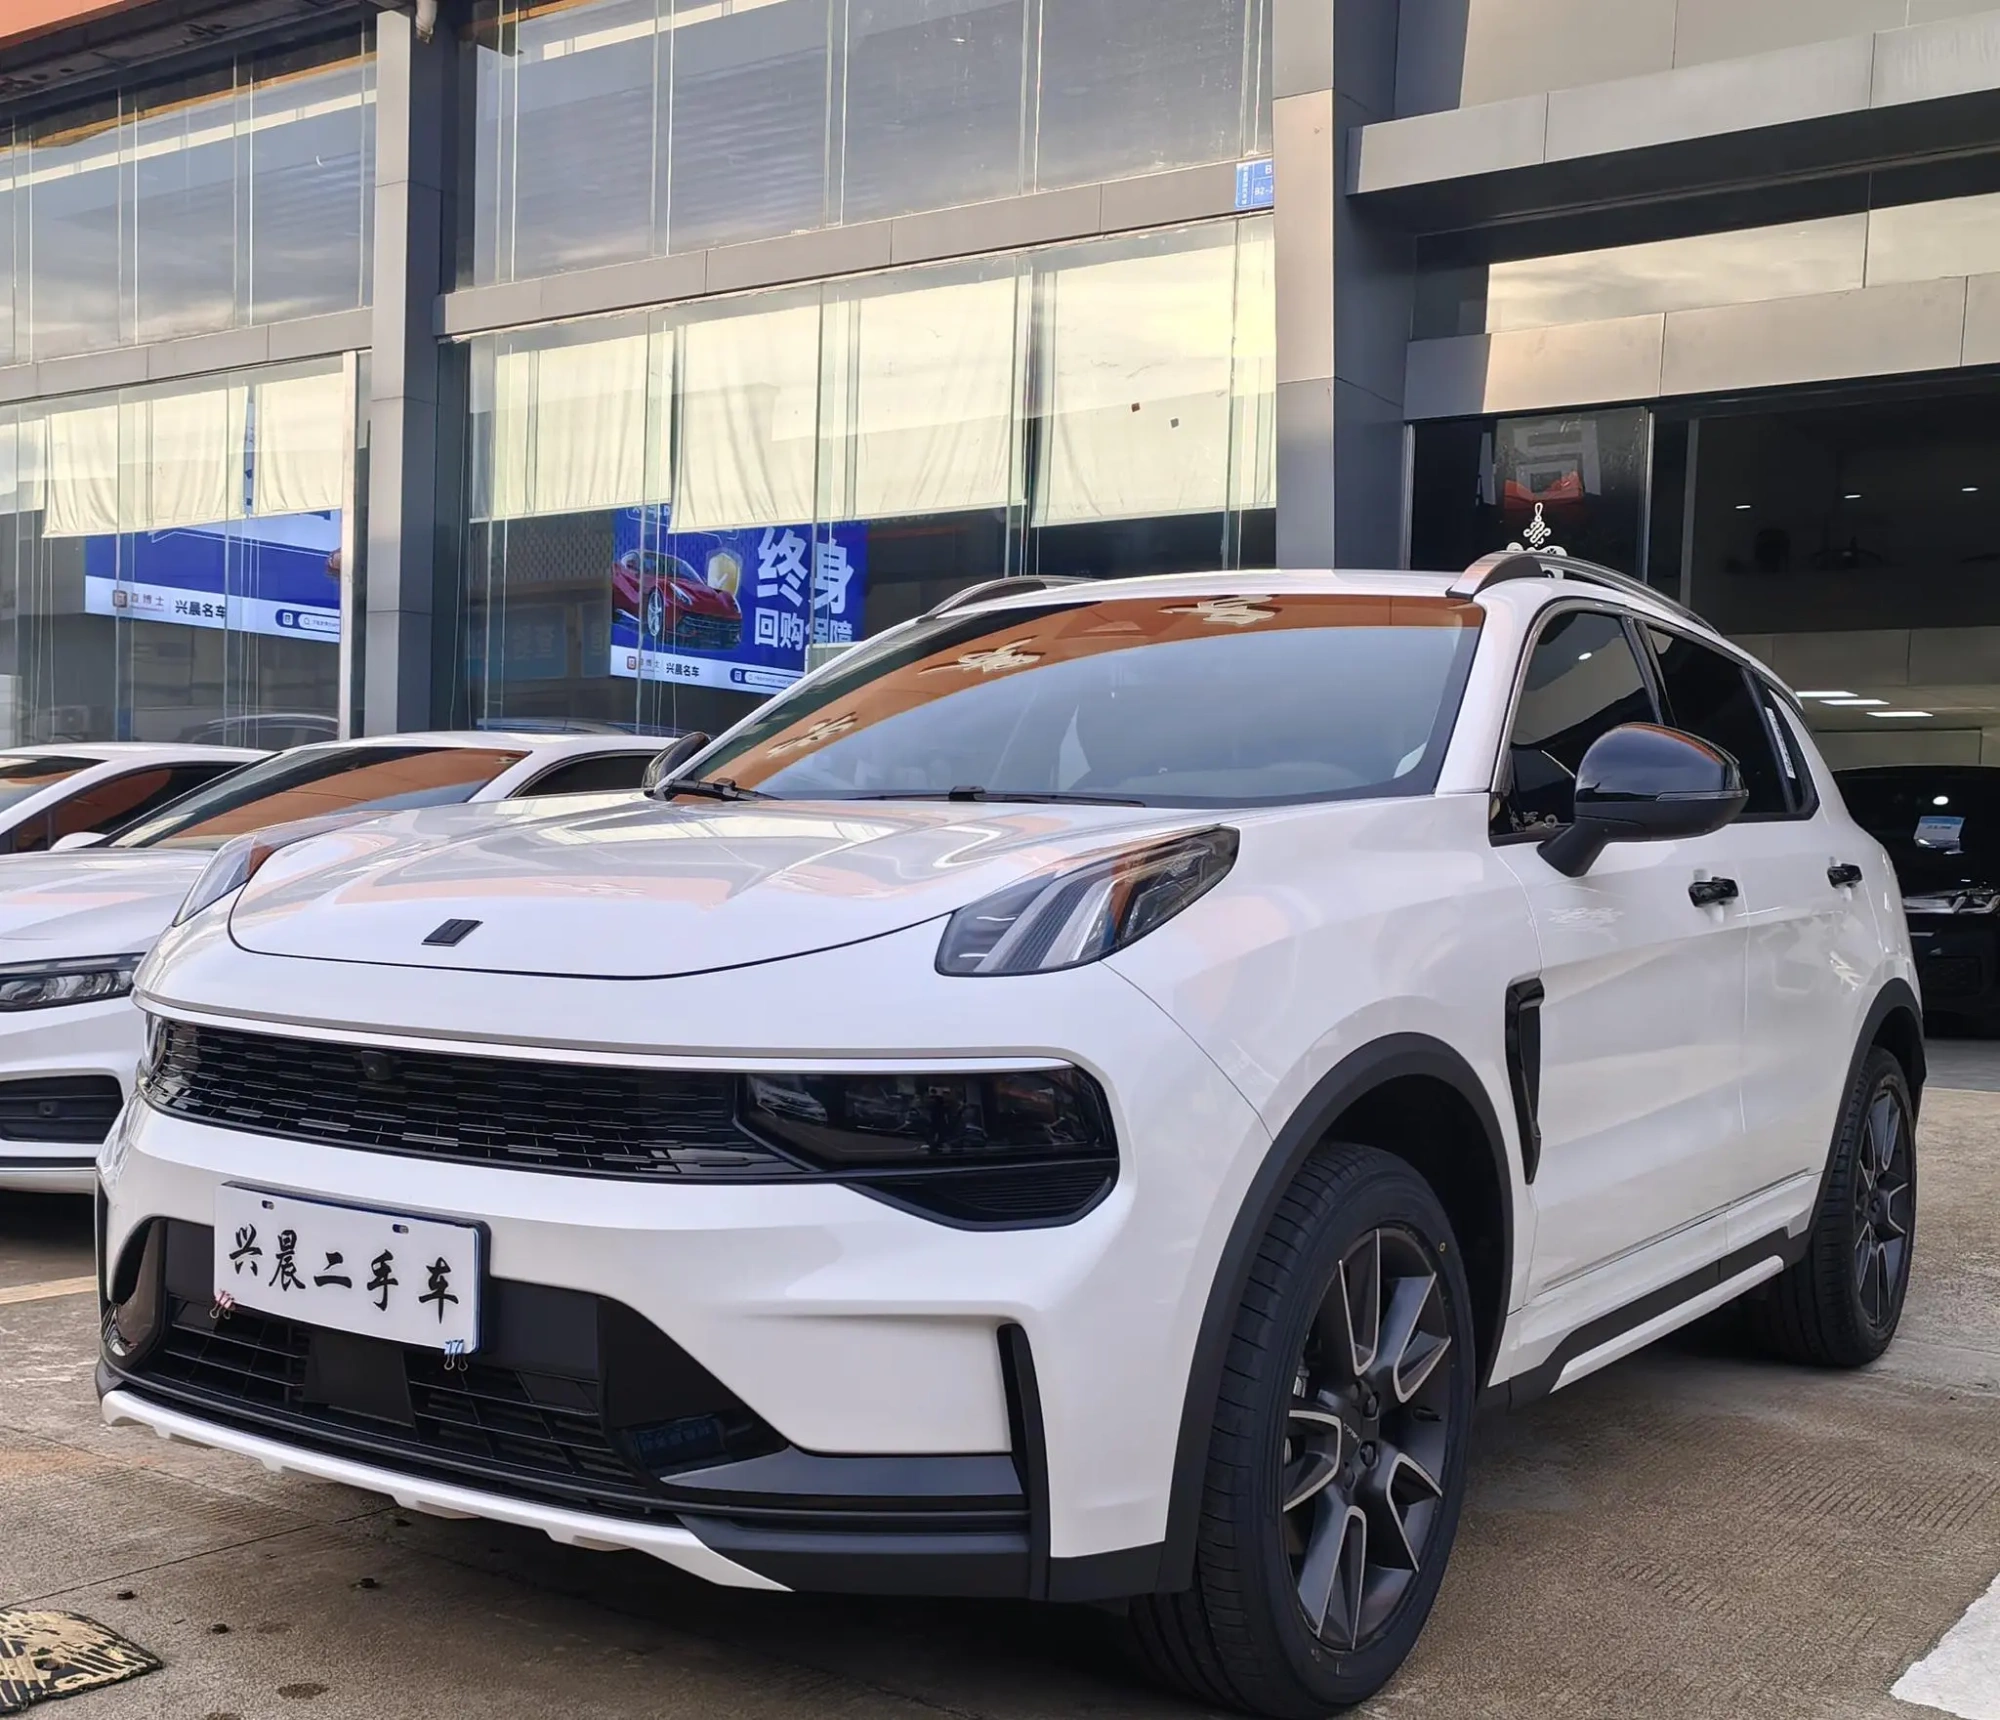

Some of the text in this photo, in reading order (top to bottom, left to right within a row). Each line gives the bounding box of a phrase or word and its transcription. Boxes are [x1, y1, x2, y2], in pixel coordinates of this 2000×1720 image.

[756, 527, 854, 613] 终身
[174, 599, 227, 619] 兴晨名车
[665, 662, 700, 677] 兴晨名车
[228, 1223, 460, 1324] 兴晨二手车
